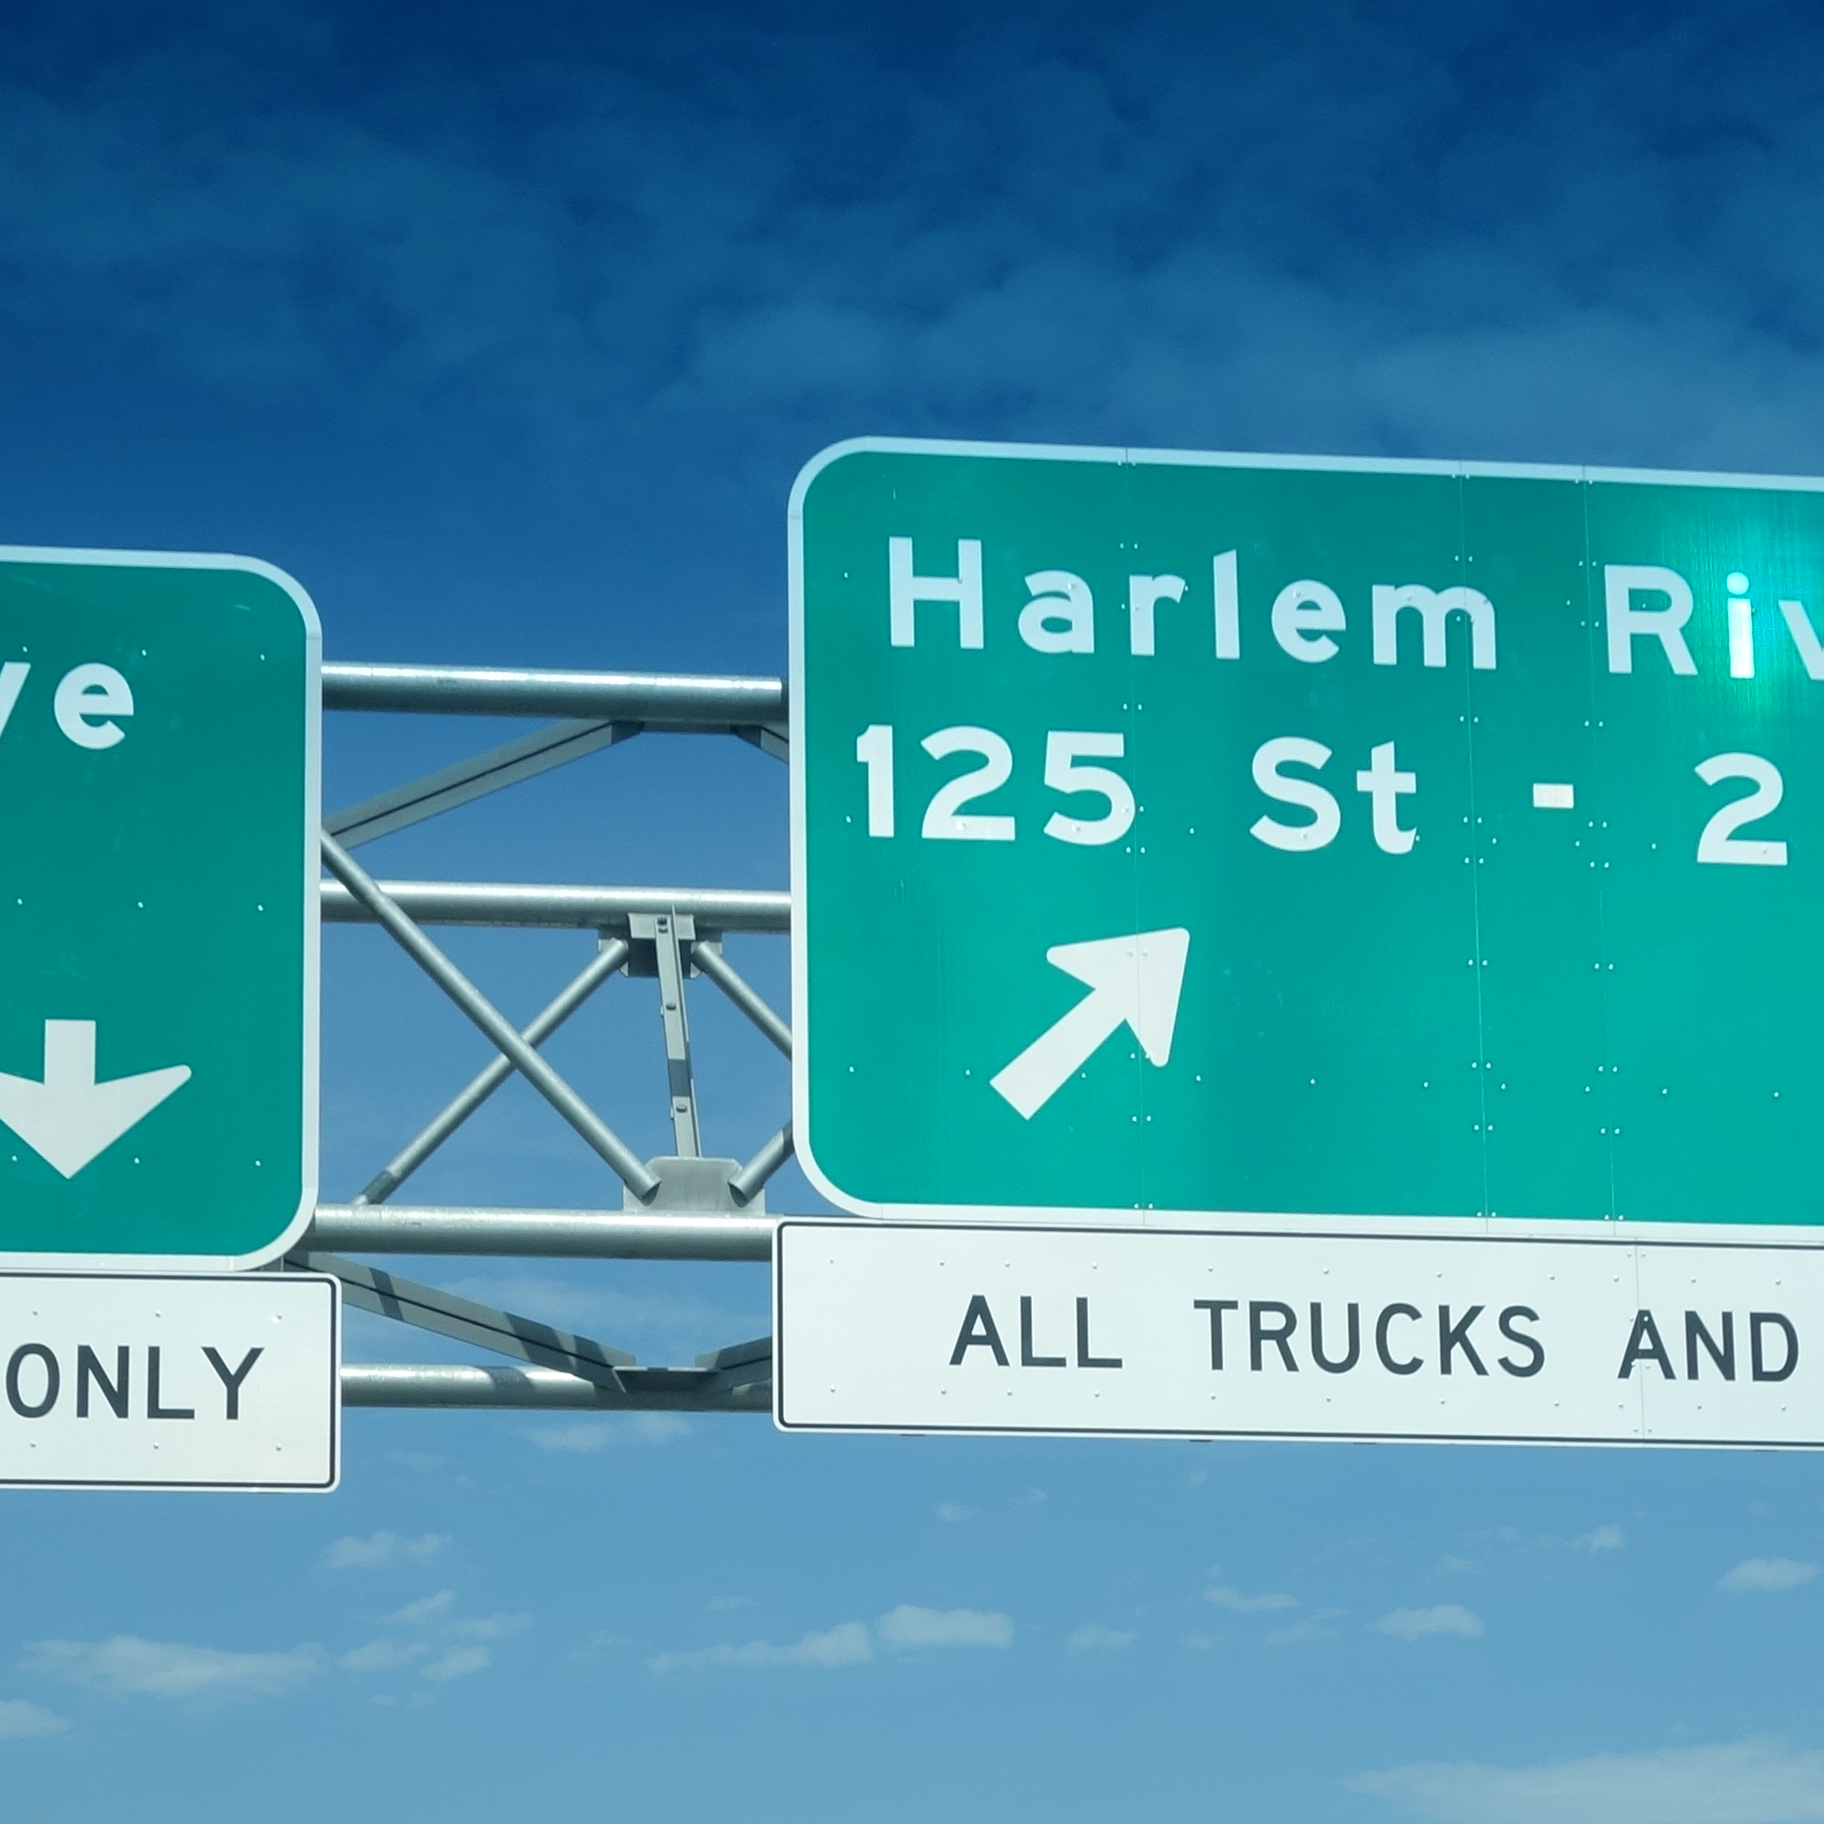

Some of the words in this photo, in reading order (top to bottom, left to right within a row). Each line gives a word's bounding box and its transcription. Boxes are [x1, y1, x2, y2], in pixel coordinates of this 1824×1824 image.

[889, 537, 1496, 669] Harlem
[857, 725, 1135, 845] 125
[1250, 737, 1416, 854] St
[1533, 784, 1574, 808] -
[1695, 753, 1787, 865] 2
[6, 1343, 263, 1419] ONLY
[950, 1295, 1122, 1368] ALL
[1194, 1300, 1544, 1377] TRUCKS
[1618, 1310, 1798, 1381] AND
